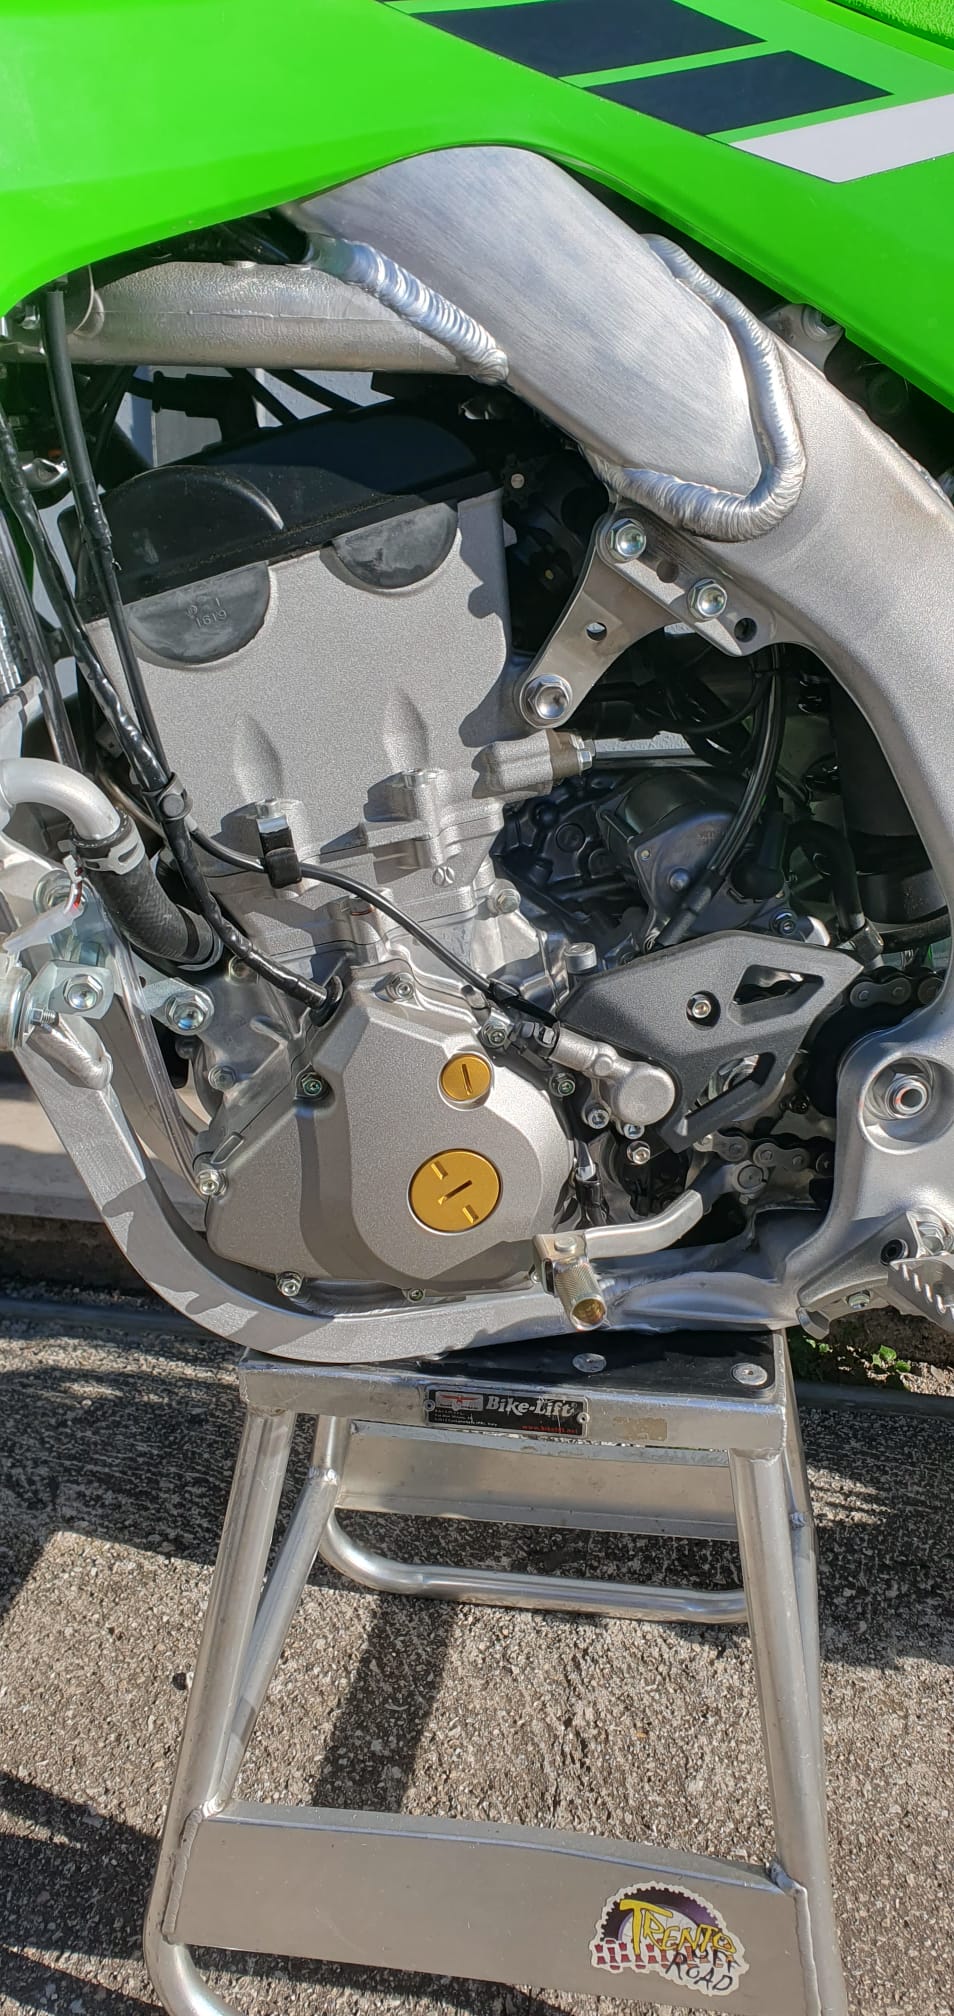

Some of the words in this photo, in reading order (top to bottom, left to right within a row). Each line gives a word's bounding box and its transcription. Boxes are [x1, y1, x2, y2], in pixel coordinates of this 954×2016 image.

[196, 609, 227, 627] 1619
[619, 1898, 737, 1956] TRENTO
[665, 1951, 734, 1991] ROAD
